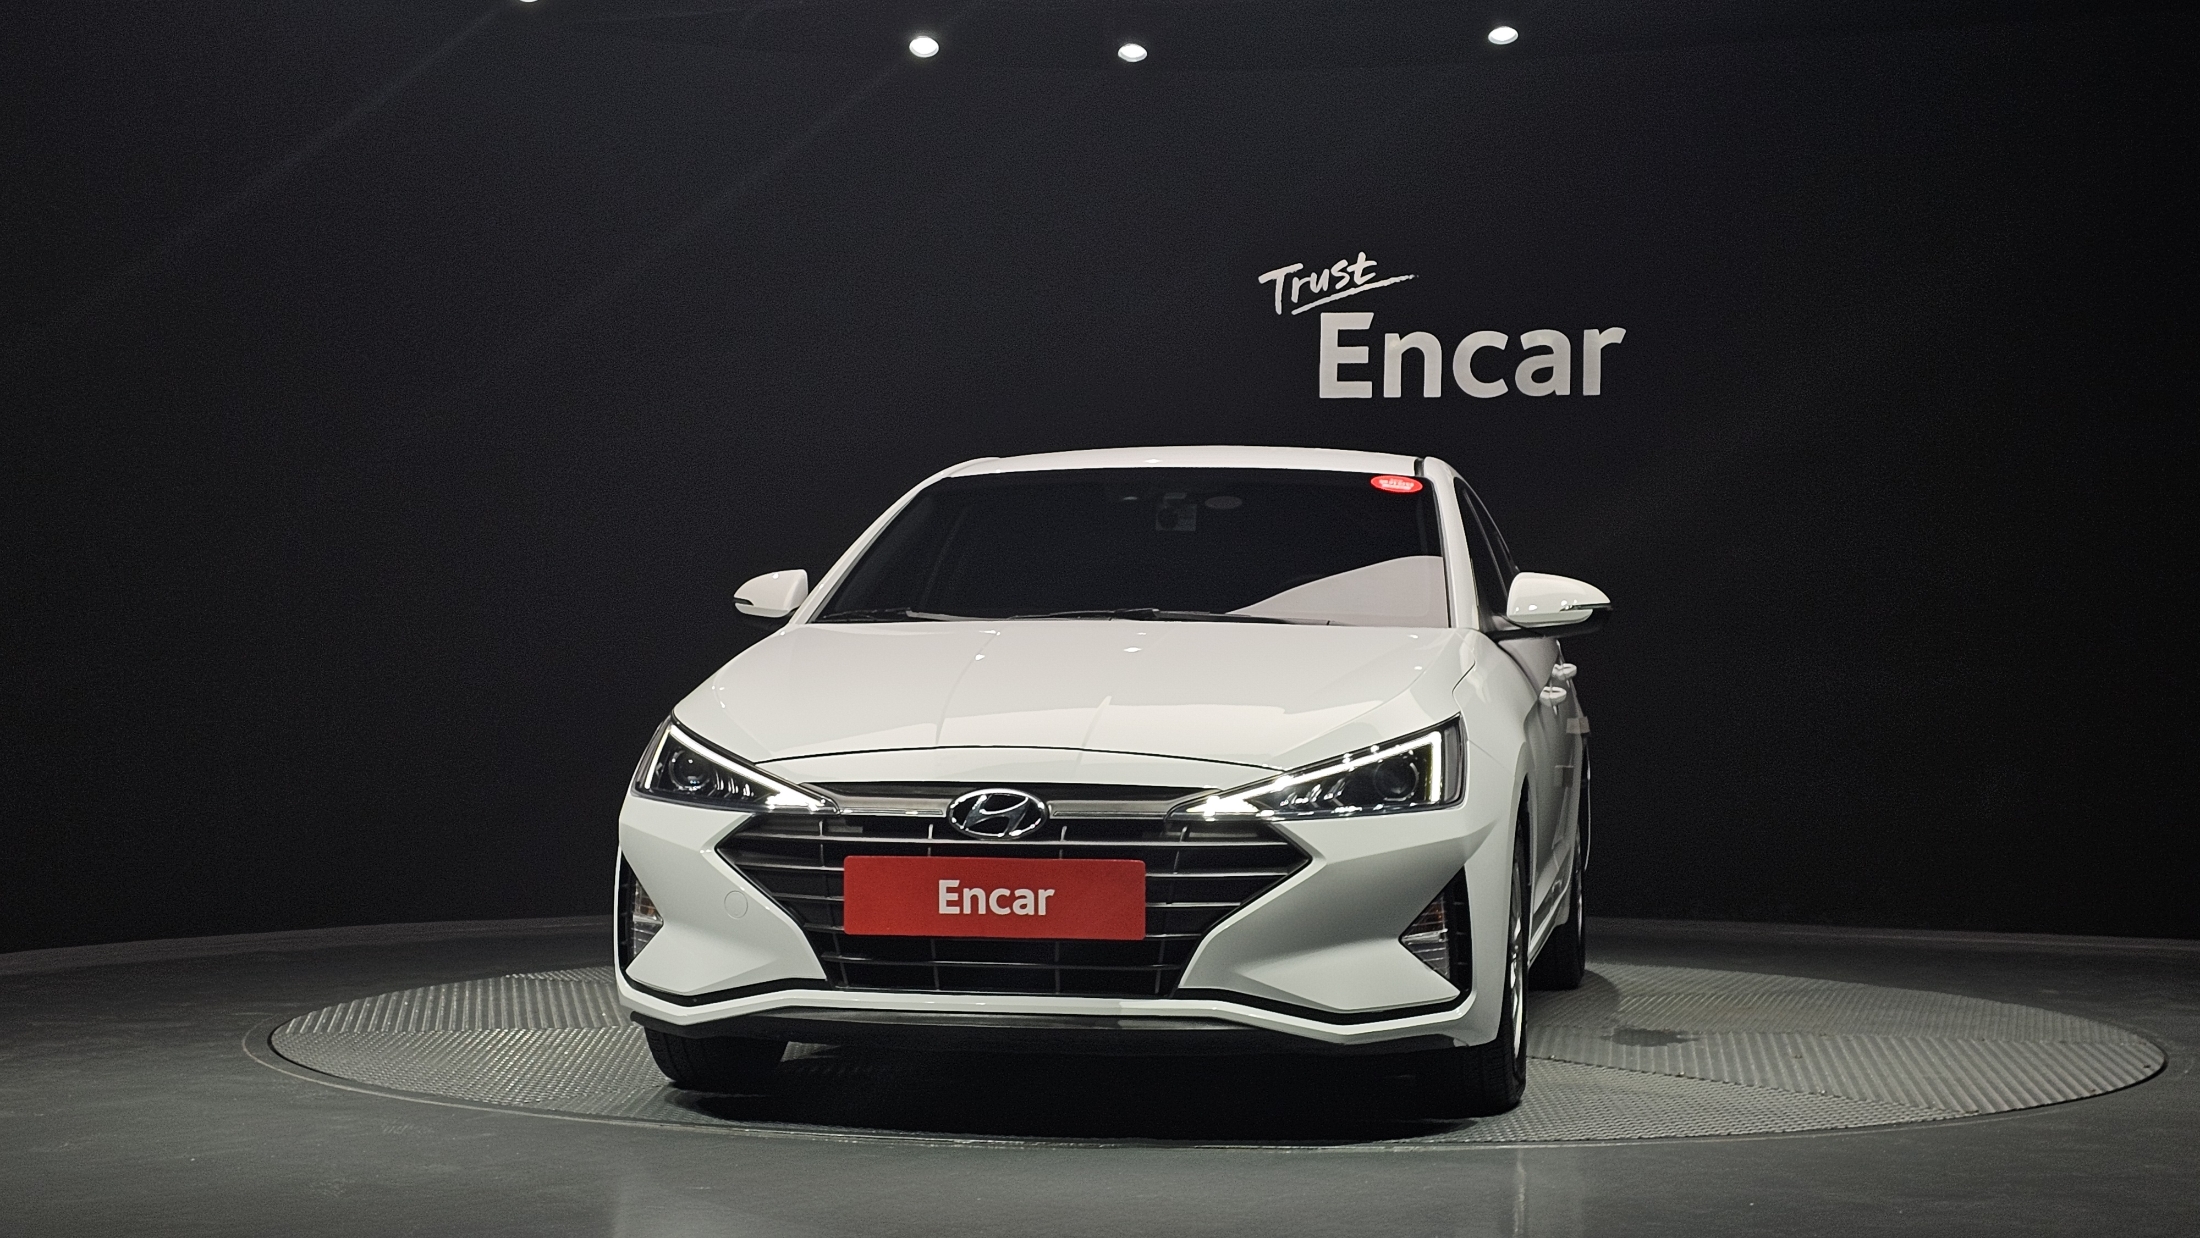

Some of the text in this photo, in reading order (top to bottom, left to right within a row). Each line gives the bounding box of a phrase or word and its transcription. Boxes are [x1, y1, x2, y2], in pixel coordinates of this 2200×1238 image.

[1258, 252, 1378, 315] Trust
[1319, 312, 1627, 399] Encar
[938, 879, 1055, 916] Encar
